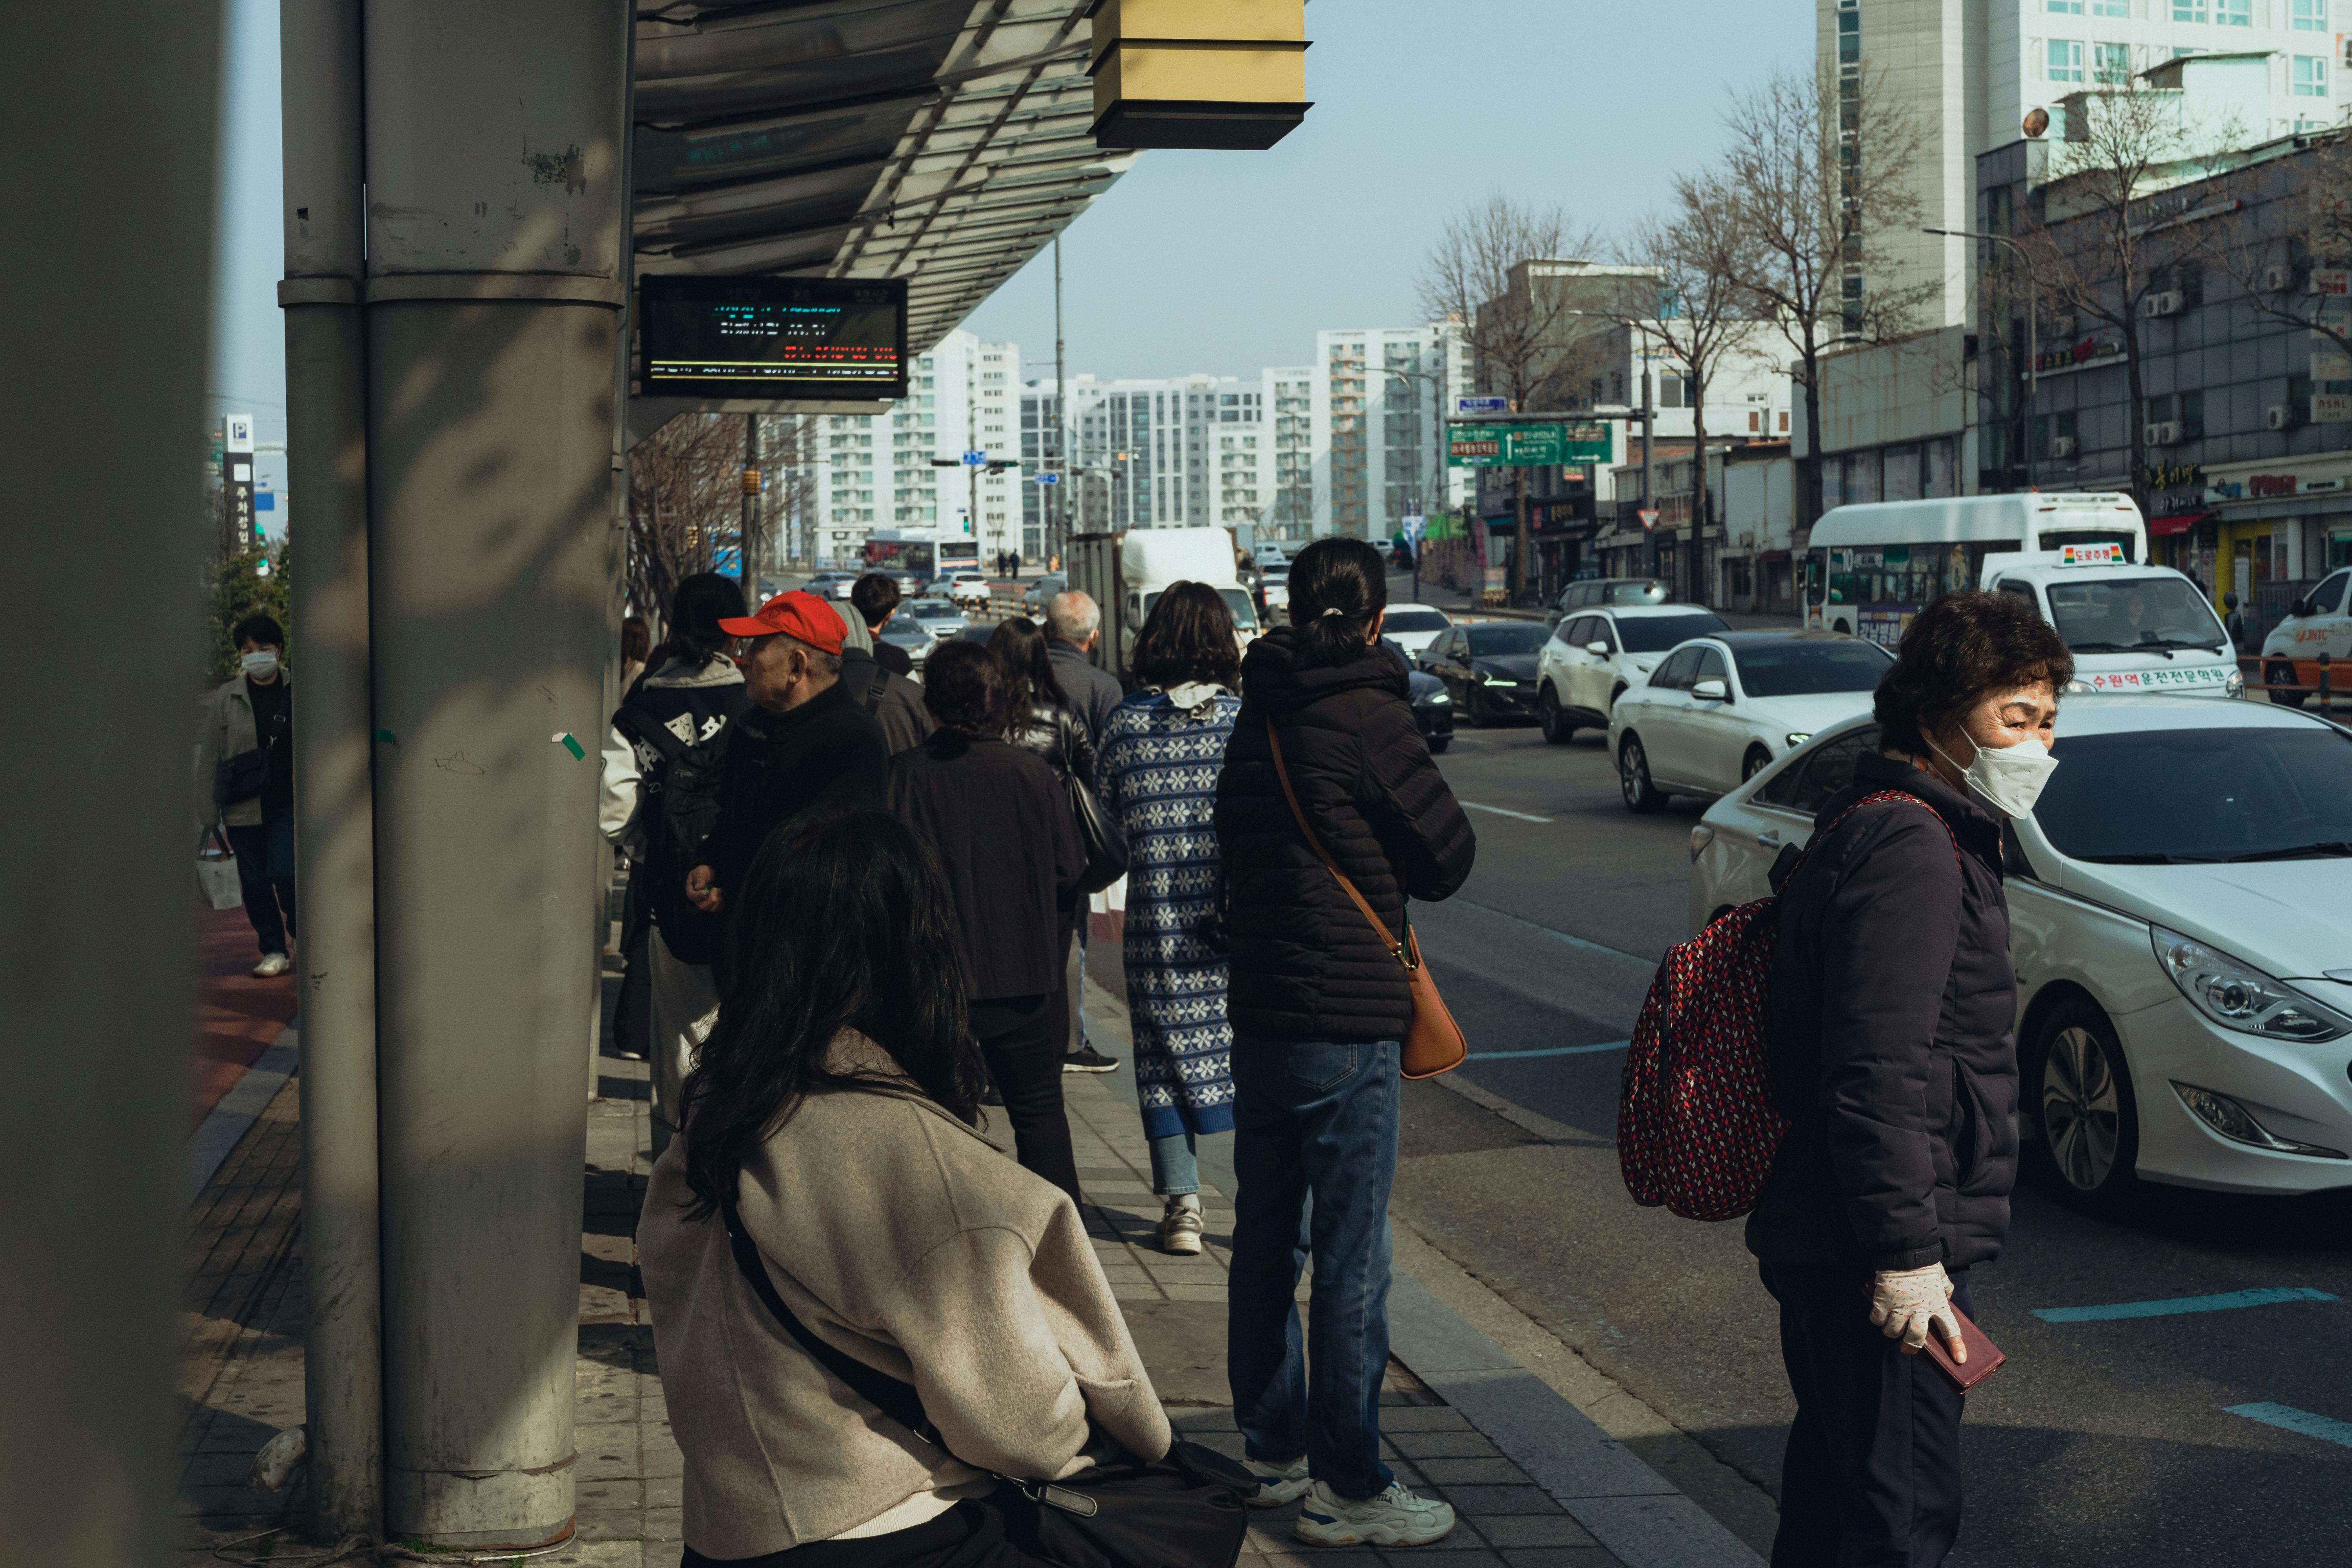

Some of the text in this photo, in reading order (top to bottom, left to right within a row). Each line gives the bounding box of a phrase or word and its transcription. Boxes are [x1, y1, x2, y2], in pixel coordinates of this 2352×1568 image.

[235, 424, 246, 439] P
[1842, 548, 1854, 573] 10
[2076, 550, 2110, 561] 도로주행
[1376, 1493, 1392, 1504] FILA
